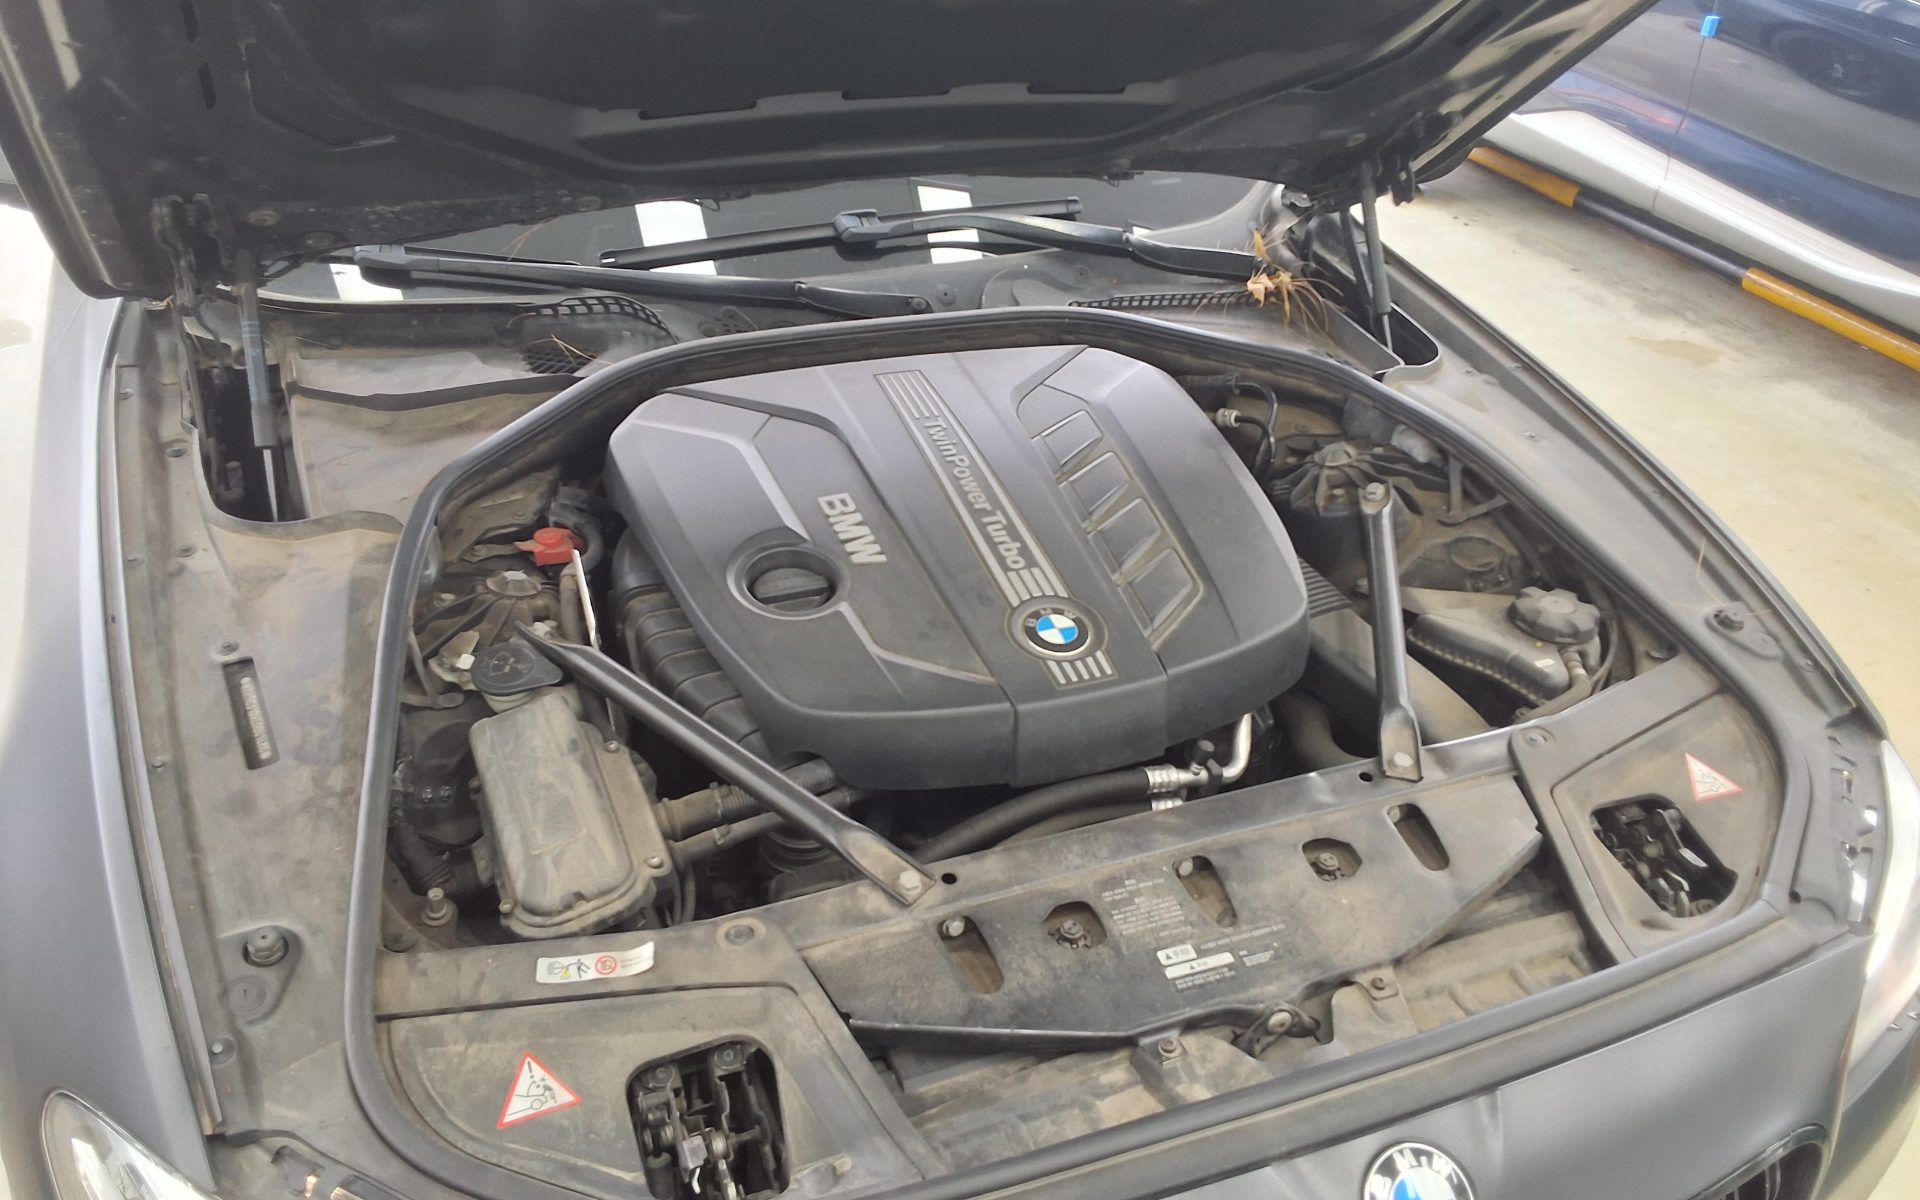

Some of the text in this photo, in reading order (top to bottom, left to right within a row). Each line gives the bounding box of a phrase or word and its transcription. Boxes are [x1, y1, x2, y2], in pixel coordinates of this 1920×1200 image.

[924, 416, 1026, 570] TwinPower Turbo
[817, 492, 888, 565] BMW
[1025, 607, 1077, 627] BMW
[1370, 1147, 1452, 1200] BMW
